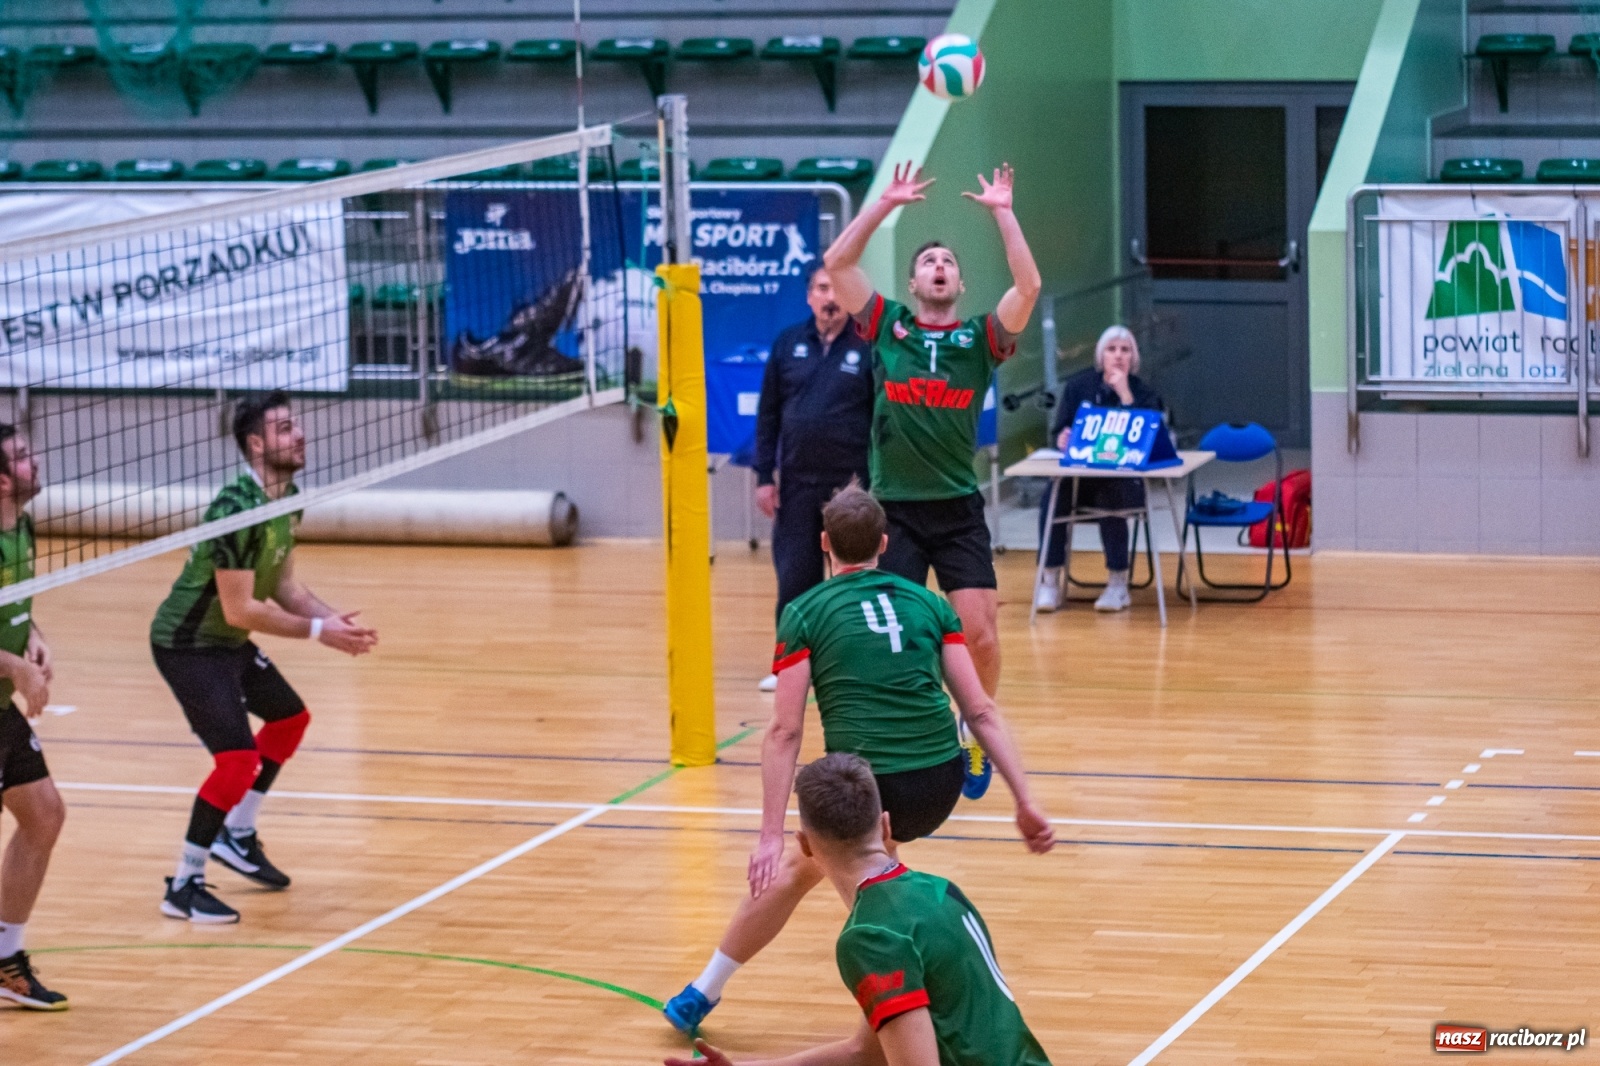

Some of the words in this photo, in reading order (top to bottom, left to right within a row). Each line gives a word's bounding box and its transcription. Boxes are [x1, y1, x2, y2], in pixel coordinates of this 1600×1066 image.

[686, 208, 742, 222] portowy
[694, 222, 781, 248] SPORT
[70, 288, 104, 321] W
[923, 340, 938, 373] 7
[1423, 328, 1521, 360] powiat
[1081, 414, 1103, 441] 10
[1127, 415, 1145, 443] 8
[860, 593, 904, 654] 4
